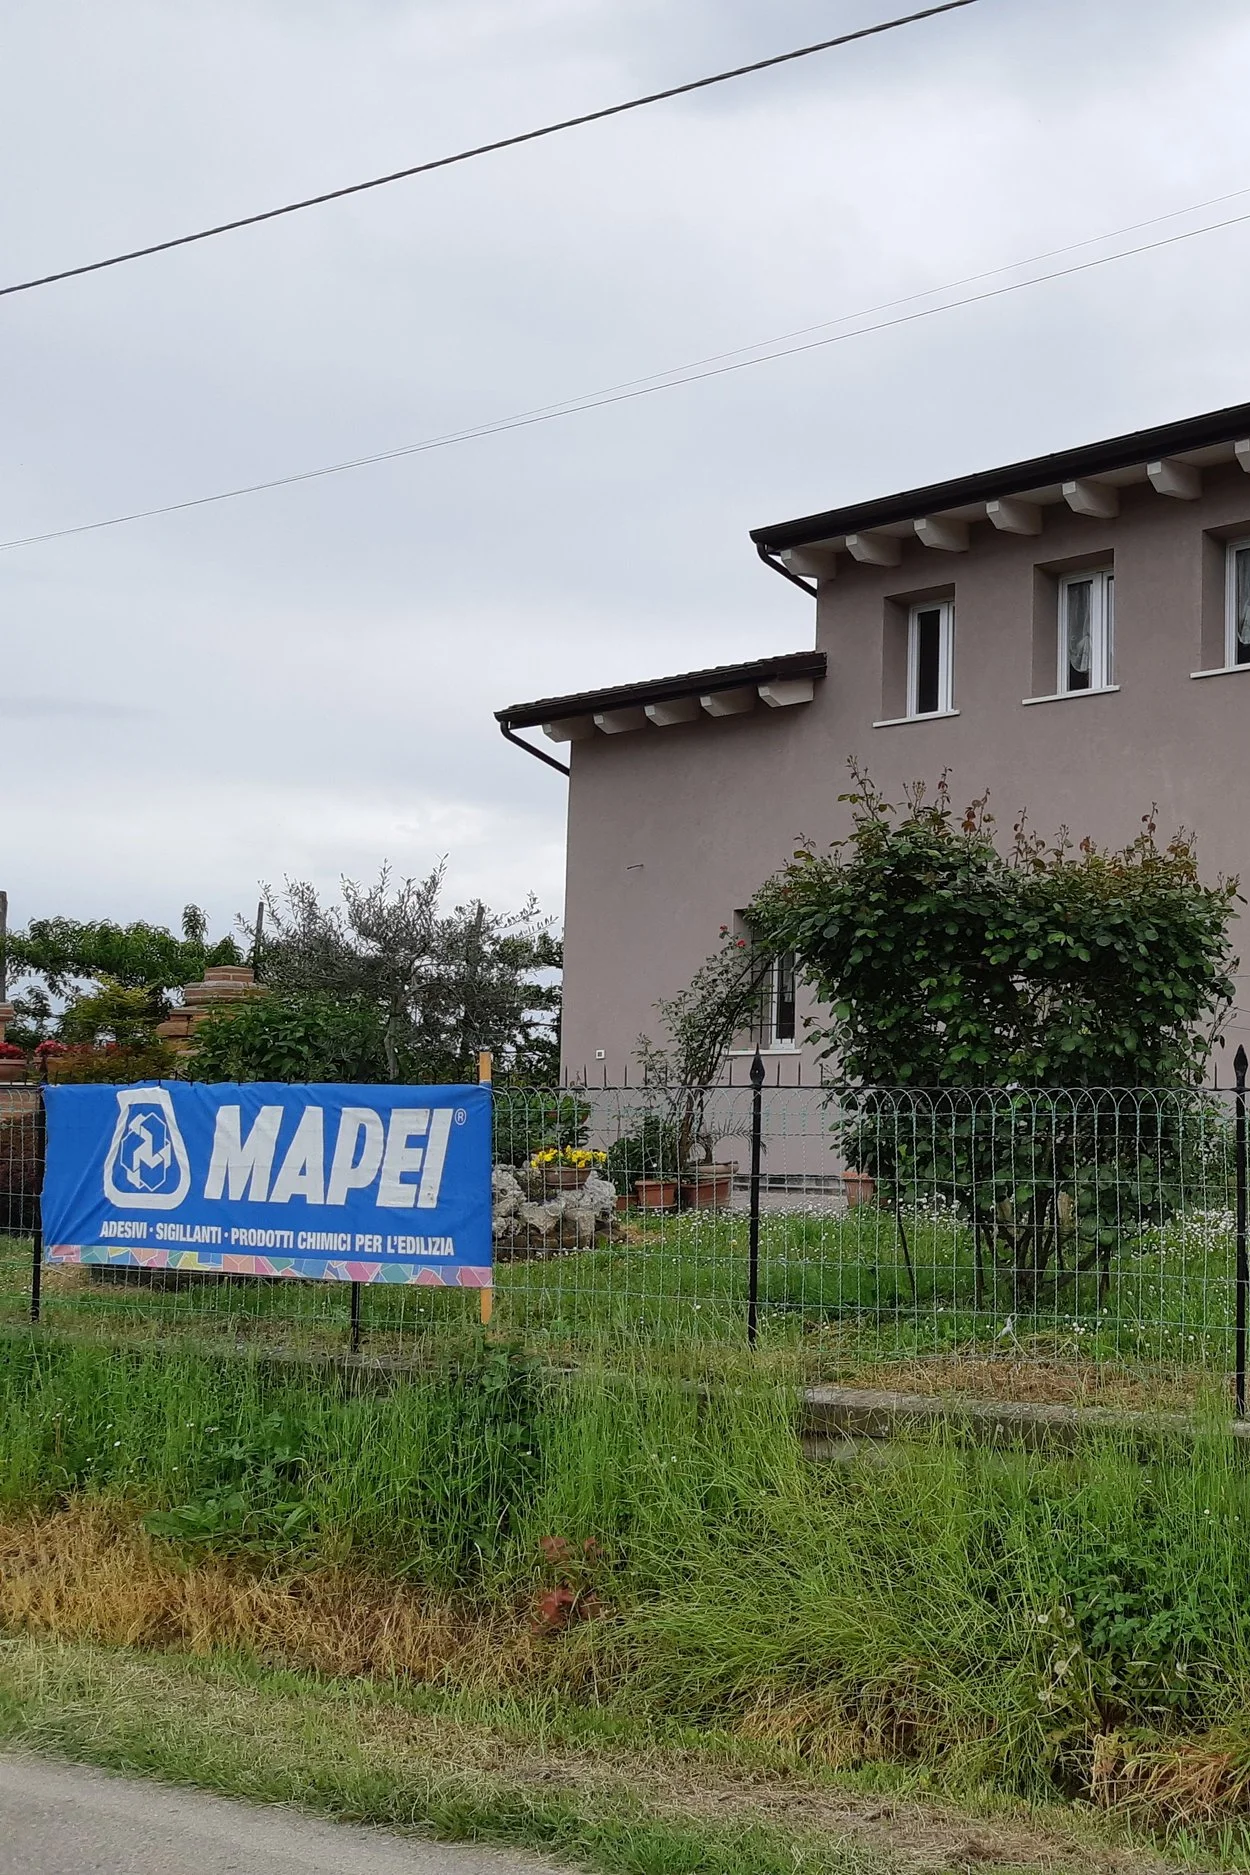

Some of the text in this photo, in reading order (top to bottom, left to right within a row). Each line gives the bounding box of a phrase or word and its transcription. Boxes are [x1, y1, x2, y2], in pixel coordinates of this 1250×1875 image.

[204, 1104, 454, 1209] MAPEI
[99, 1220, 455, 1256] ADESIVI SIGILLANTI PRODOTTI CHIMICI PER L'EDILIZIA
